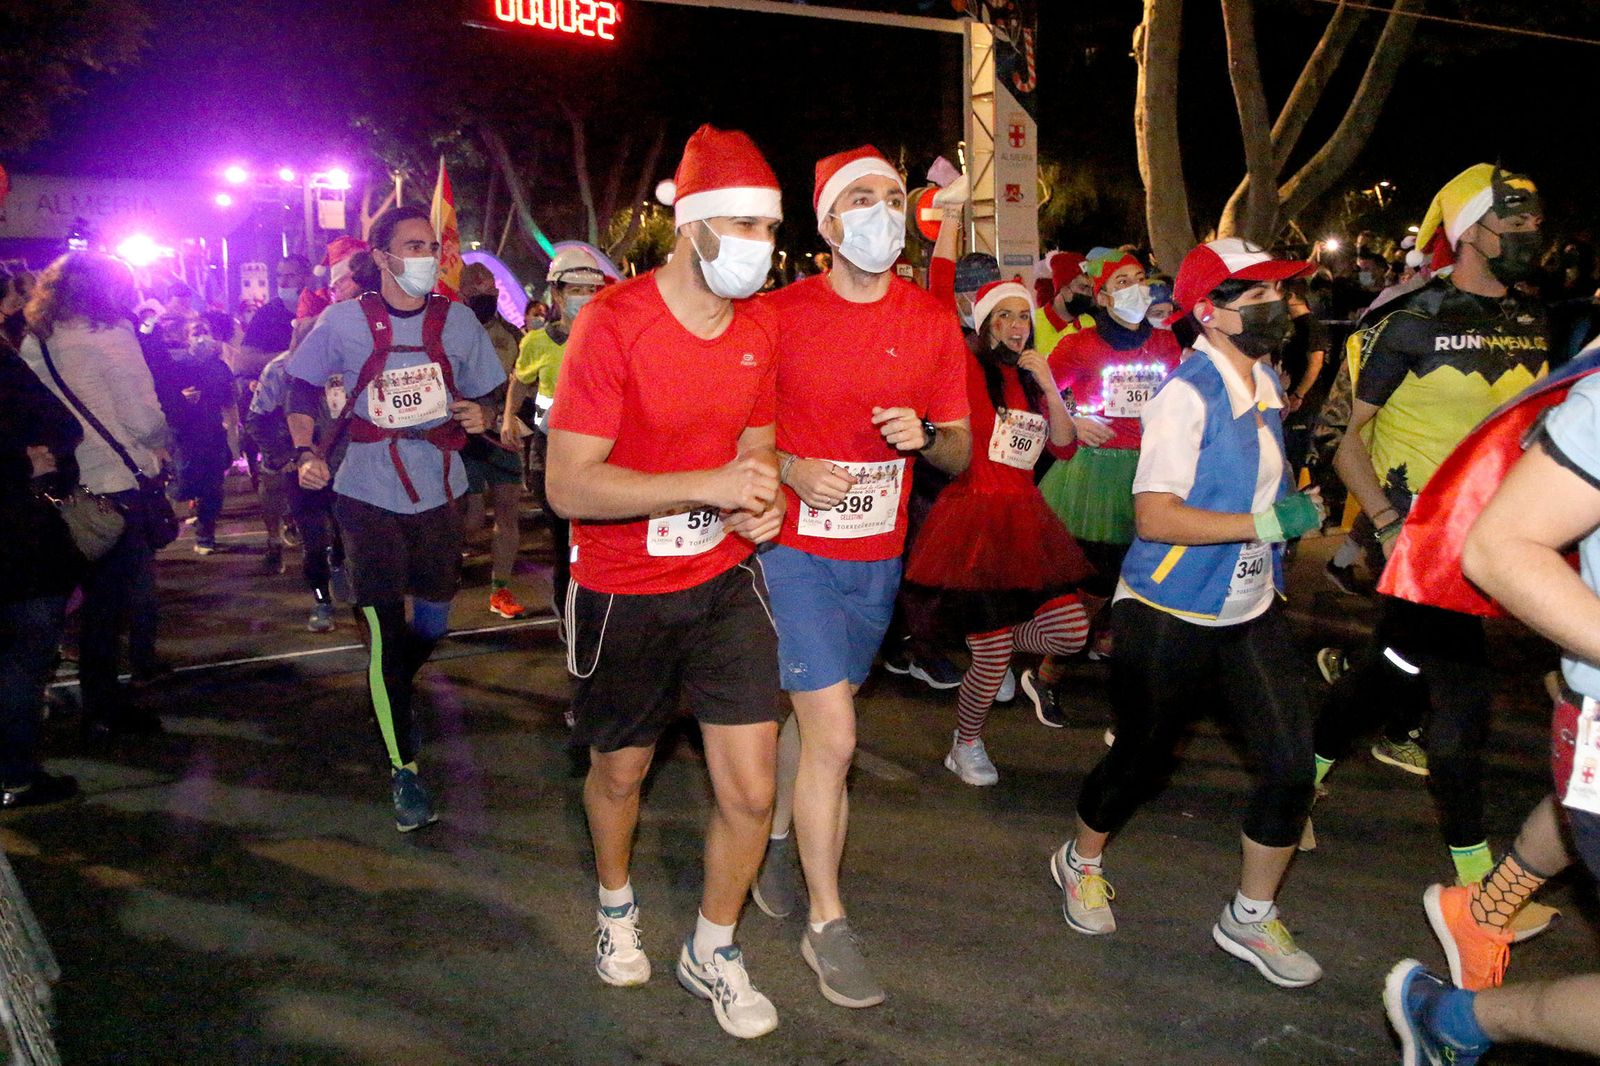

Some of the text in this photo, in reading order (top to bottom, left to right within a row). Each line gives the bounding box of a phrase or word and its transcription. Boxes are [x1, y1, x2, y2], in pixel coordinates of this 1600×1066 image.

[392, 392, 422, 408] 608
[1127, 390, 1149, 402] 361
[1010, 435, 1032, 451] 360
[836, 495, 873, 513] 598
[1236, 558, 1263, 578] 340
